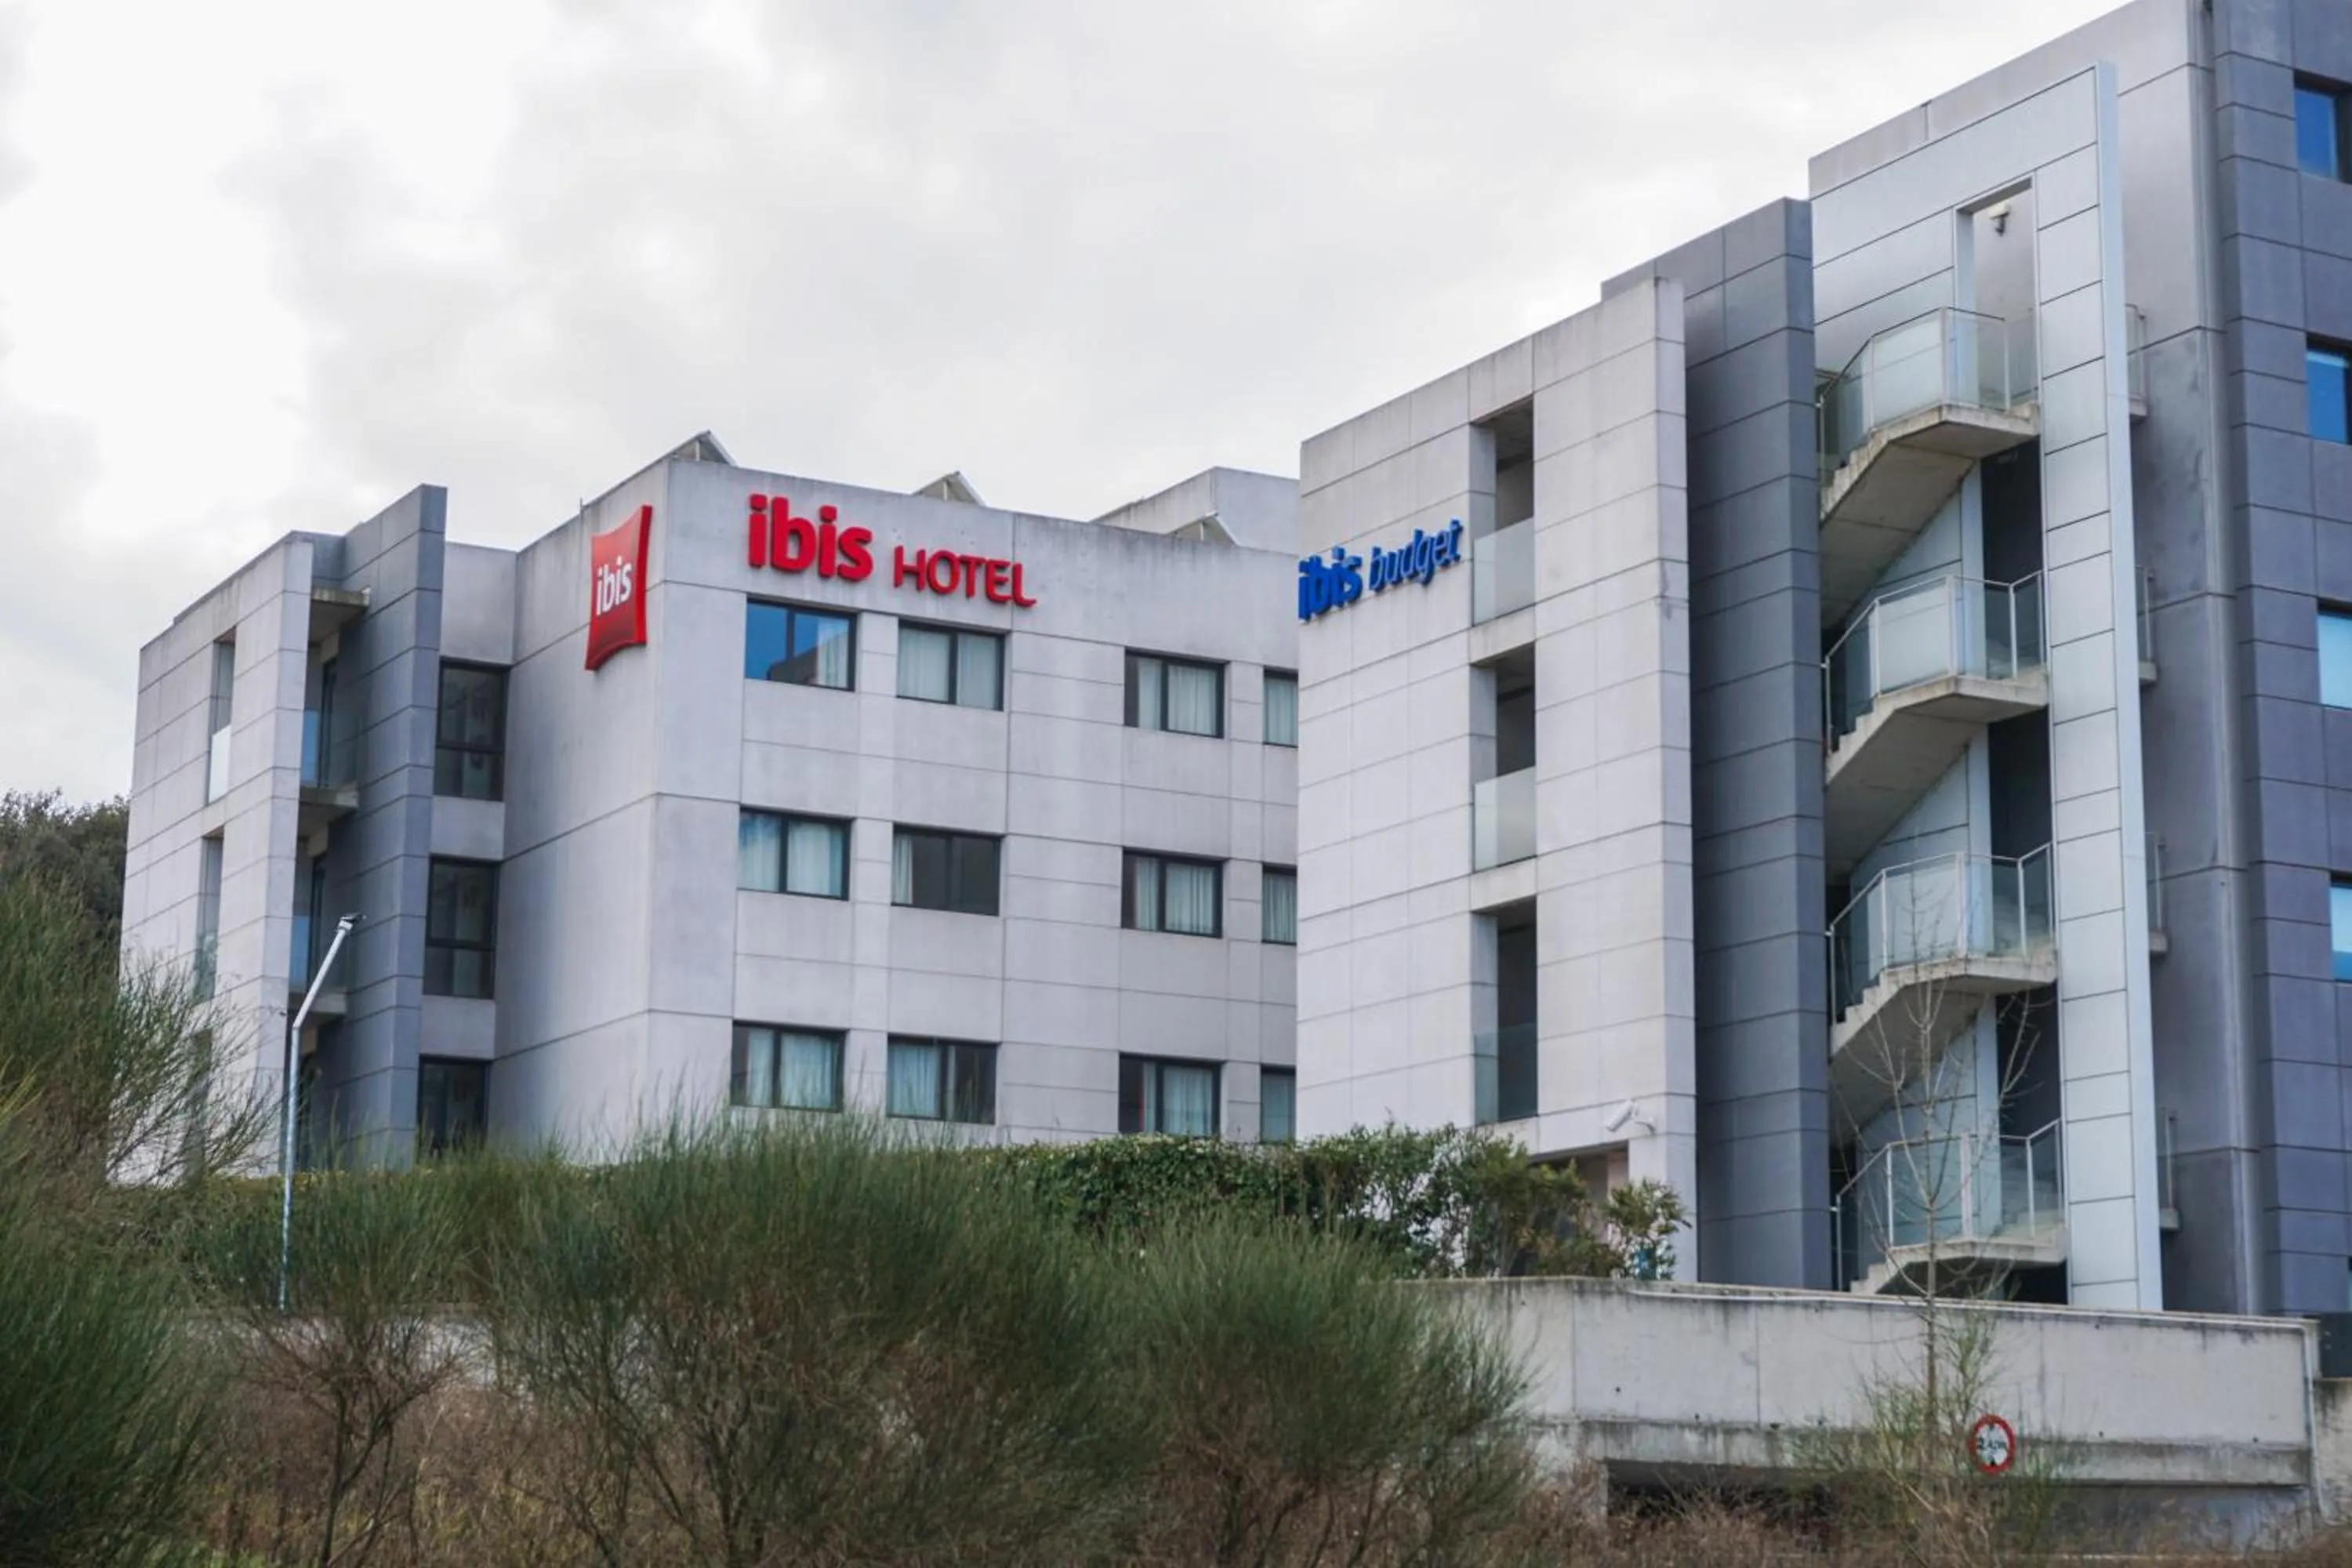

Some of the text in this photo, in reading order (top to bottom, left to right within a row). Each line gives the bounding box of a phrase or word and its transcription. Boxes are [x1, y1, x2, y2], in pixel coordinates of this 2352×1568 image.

[596, 555, 633, 616] ibis
[748, 494, 1036, 607] ibis HOTEL
[1298, 519, 1462, 620] ibis budget
